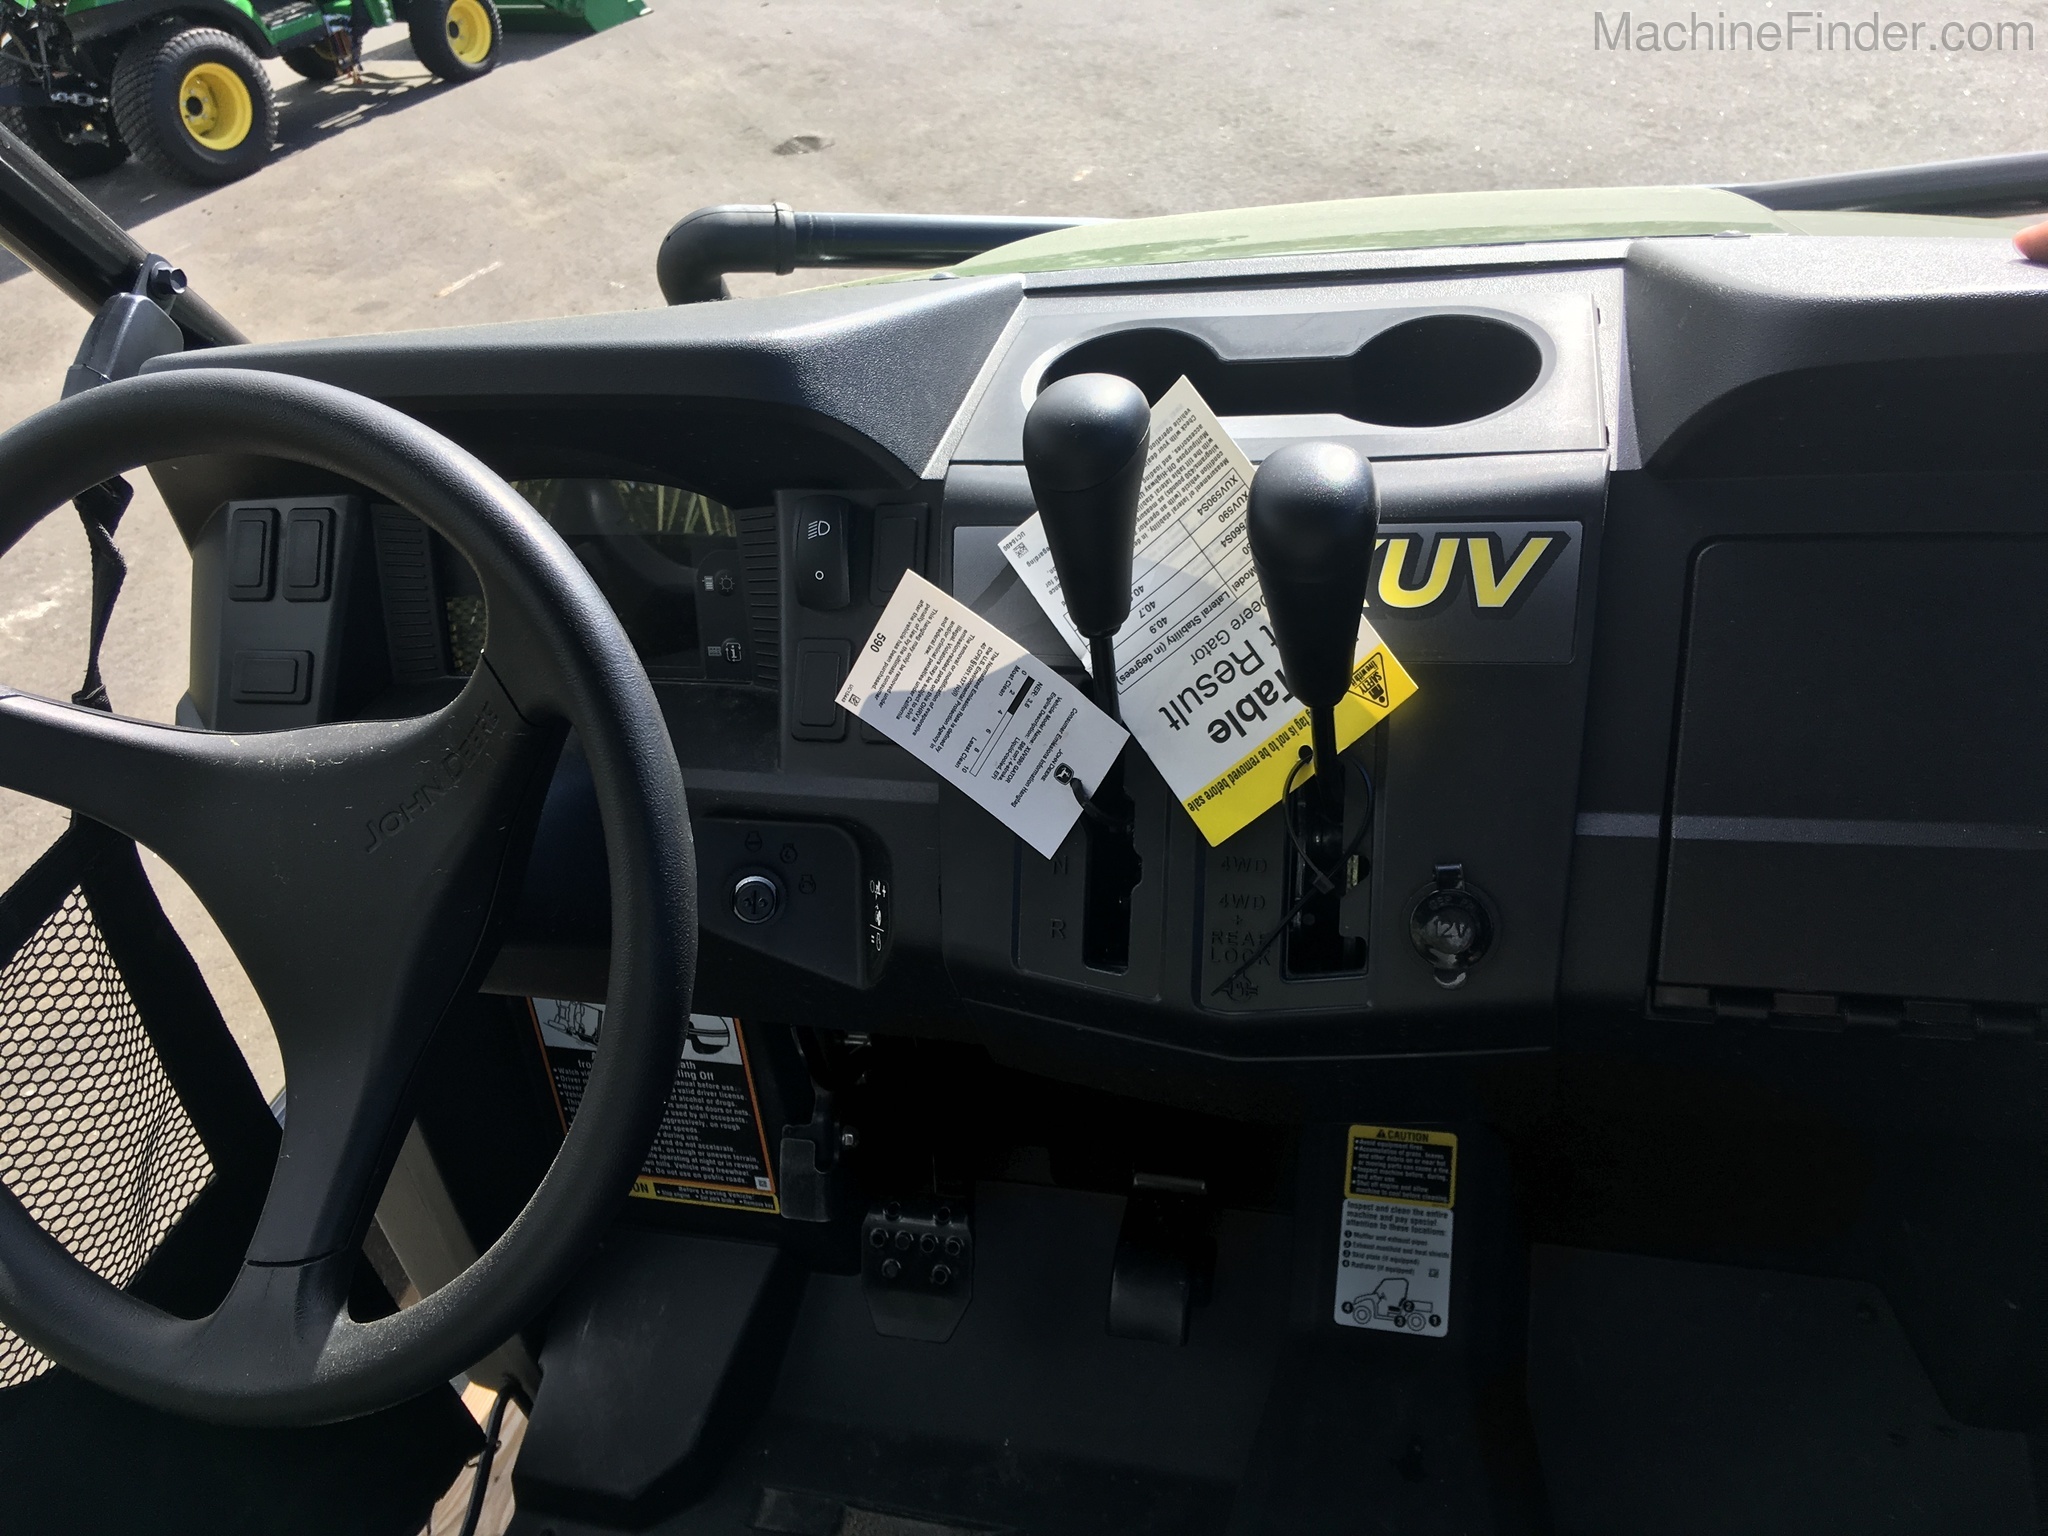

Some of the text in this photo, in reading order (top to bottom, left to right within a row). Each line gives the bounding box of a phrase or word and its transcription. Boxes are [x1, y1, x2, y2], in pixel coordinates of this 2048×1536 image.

[1172, 408, 1190, 427] vehicle
[1157, 414, 1196, 453] Check with your
[1161, 424, 1202, 466] accessories, and
[1144, 430, 1208, 492] Multipurpose Off-Highway
[1153, 437, 1213, 496] with the tilt table lateral
[1184, 444, 1220, 479] kilograms/430
[1199, 450, 1223, 474] condition
[1180, 473, 1200, 492] vehicle
[1191, 457, 1229, 492] Measurement
[1163, 475, 1185, 497] pounds)
[1196, 474, 1238, 515] XUV590S4
[1166, 490, 1181, 505] (with
[1170, 495, 1189, 514] lateral
[1218, 490, 1247, 522] XUV590
[1137, 510, 1160, 532] operator
[1147, 513, 1169, 532] stability,
[1231, 568, 1255, 591] Model
[1363, 538, 1553, 608] UV
[1138, 600, 1155, 618] 40.7
[1149, 616, 1167, 633] 40.9
[870, 632, 886, 652] 590
[1117, 590, 1230, 684] Lateral Stability (in degrees)
[973, 648, 982, 661] CFR
[984, 646, 992, 655] the
[990, 651, 999, 661] The
[1190, 629, 1230, 665] Gator
[978, 655, 988, 665] U.S.
[1363, 660, 1378, 675] live
[958, 665, 981, 701] Environmental
[973, 660, 993, 689] Normalized
[1353, 668, 1370, 684] with
[1356, 670, 1382, 694] SAFETY
[1159, 640, 1263, 729] Result
[960, 688, 976, 711] Emission
[1023, 681, 1042, 708] NER: 3.6
[1042, 691, 1056, 709] Engine
[943, 700, 961, 725] Protection
[1048, 696, 1062, 714] Vehicle
[953, 710, 963, 723] Rate
[954, 664, 1020, 768] Most Clean Least Clean
[1024, 709, 1045, 738] Description:
[1038, 713, 1051, 730] Model
[932, 724, 946, 743] Agency
[939, 727, 952, 746] defined
[1028, 728, 1041, 745] Name:
[991, 736, 1020, 779] Liquid-cooled, EFI
[1010, 707, 1077, 807] Consumer Emissions Information Hangtag
[1040, 748, 1063, 781] JOHN DEERE
[1187, 715, 1310, 811] tag is not to be removed before sale
[961, 765, 968, 773] 10
[1004, 764, 1018, 783] GATOR
[366, 776, 446, 854] JOHN
[1221, 856, 1267, 872] 4WD
[1218, 893, 1265, 910] 4WD
[1050, 918, 1066, 938] R
[557, 1067, 579, 1075] Watch
[559, 1074, 580, 1083] Driver
[698, 1070, 714, 1081] Off
[561, 1082, 582, 1091] Never
[676, 1087, 695, 1095] valid
[696, 1088, 717, 1097] driver
[696, 1081, 720, 1090] before
[677, 1094, 704, 1104] alcohol
[688, 1103, 704, 1112] side
[704, 1105, 724, 1114] doors
[1387, 1129, 1428, 1142] CAUTION
